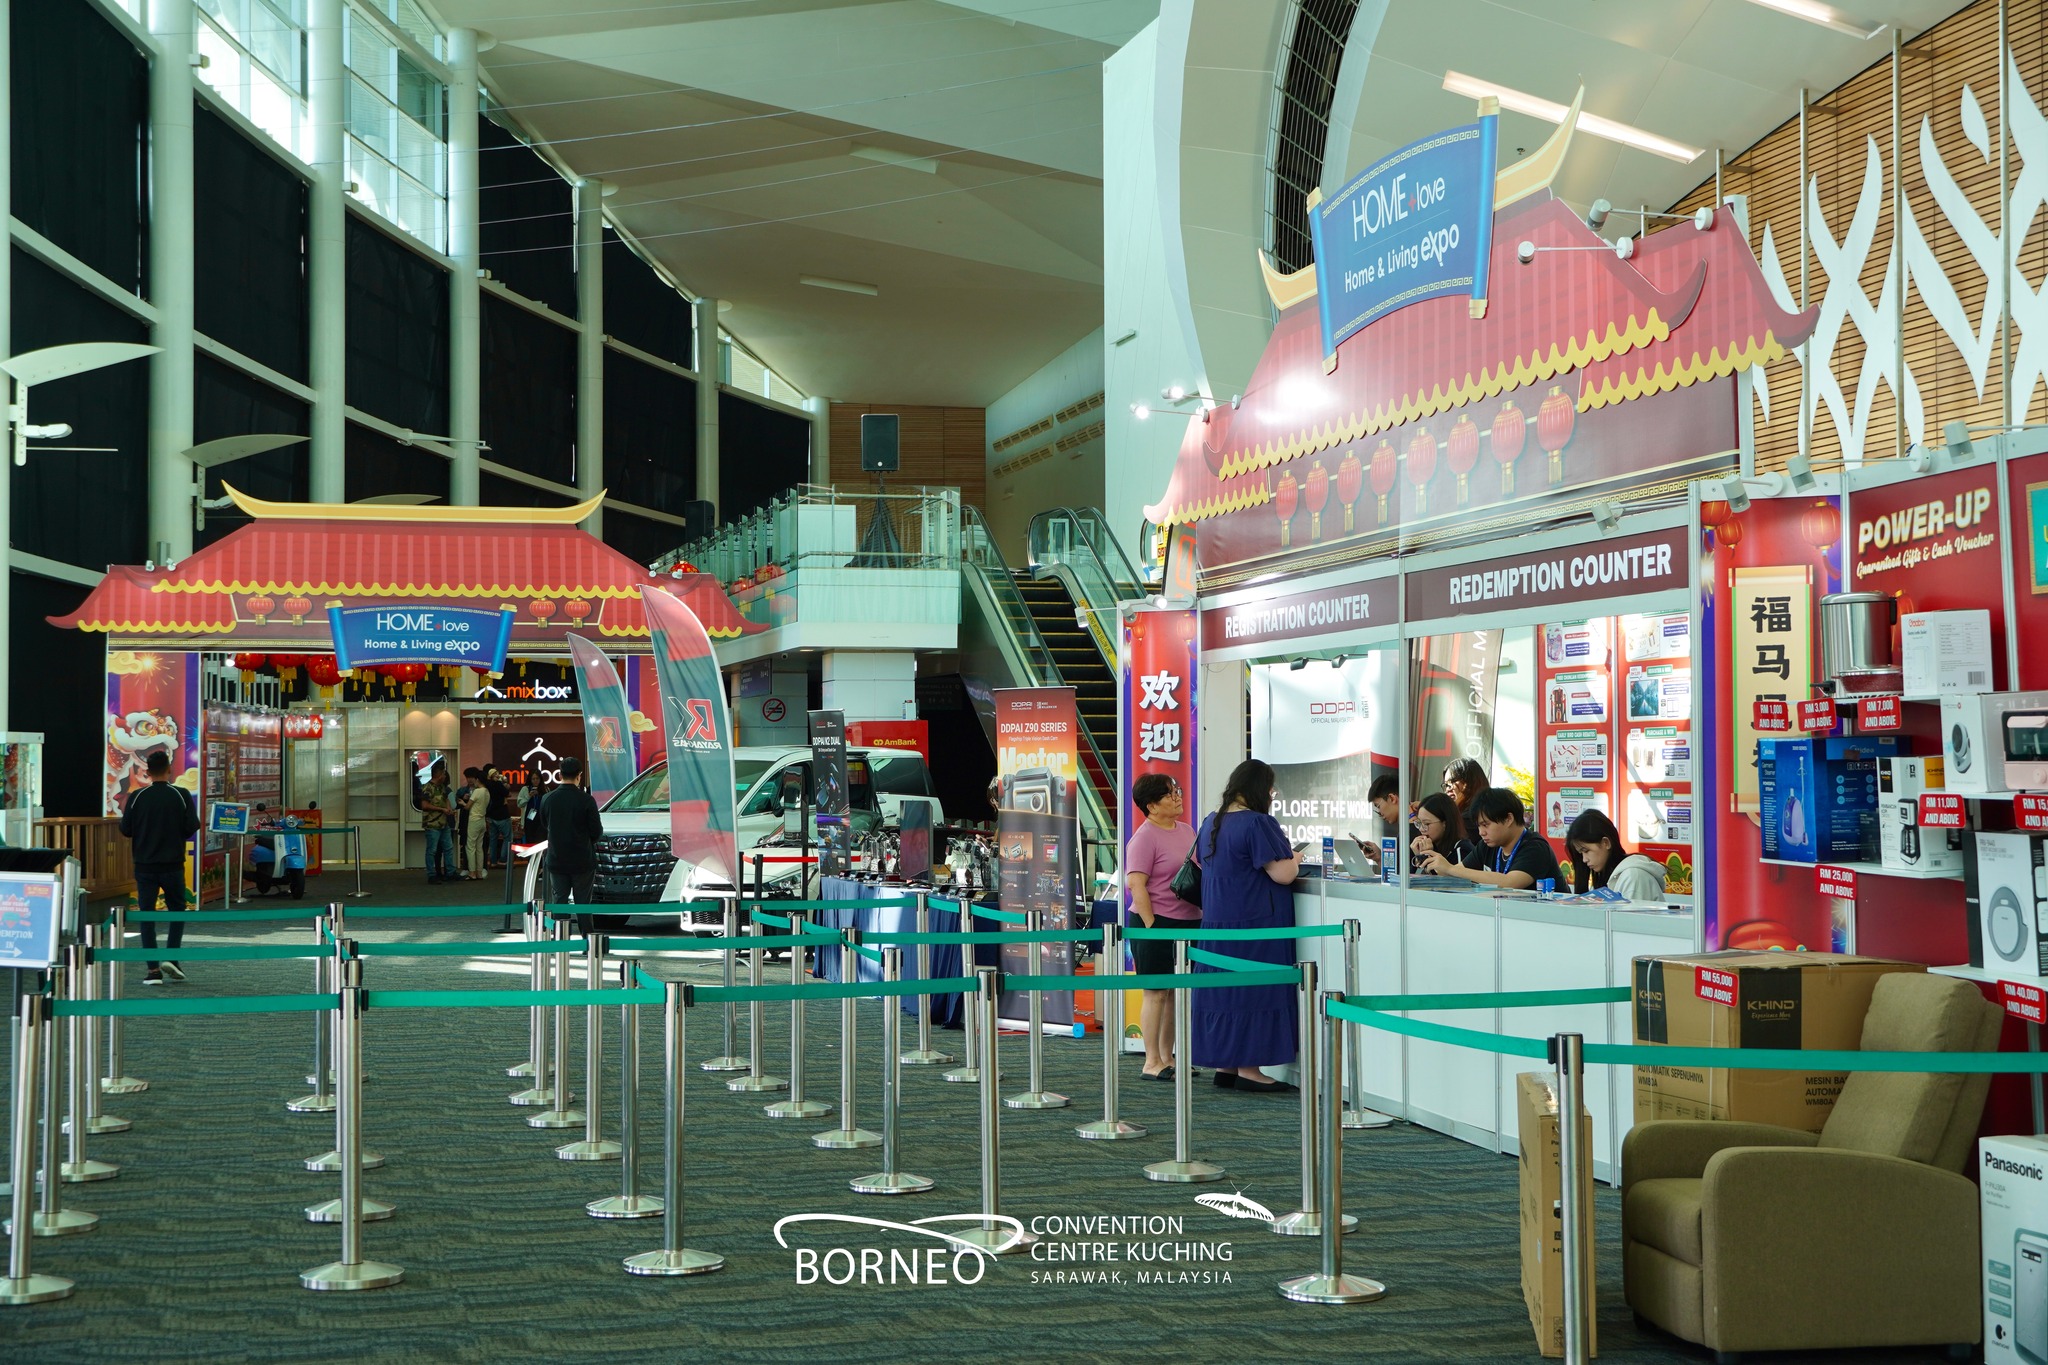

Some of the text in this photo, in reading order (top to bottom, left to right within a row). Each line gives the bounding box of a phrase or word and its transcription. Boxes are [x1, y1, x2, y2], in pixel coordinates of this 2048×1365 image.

[1352, 173, 1445, 241] HOME love
[1345, 223, 1459, 293] Home & Living expo
[1858, 487, 1990, 555] POWER-UP
[1856, 532, 1994, 579] Guaranteed Gifts & Cash Voucher
[1450, 543, 1672, 604] REDEMPTION COUNTER
[377, 613, 469, 632] HOME love
[1226, 593, 1369, 638] REGISTRATION COUNTER
[364, 638, 480, 655] Home & Living expo
[507, 679, 568, 699] mixbox
[1310, 702, 1356, 714] DDPAI
[1467, 657, 1485, 758] OFFICIAL
[1760, 704, 1782, 715] RM 1,000
[1805, 702, 1829, 713] RM 3,000
[1866, 700, 1893, 712] RM 7,000
[1000, 722, 1067, 733] DDPAI Z90 SERIES
[1759, 719, 1785, 728] AND ABOVE
[1804, 716, 1832, 728] AND ABOVE
[1865, 715, 1896, 727] AND ABOVE
[1000, 747, 1068, 775] Master
[1321, 800, 1346, 818] THE
[1926, 797, 1958, 809] RM 11,000
[2023, 798, 2035, 810] RM
[1924, 813, 1959, 824] AND ABOVE
[2025, 815, 2041, 827] AND
[1820, 868, 1852, 883] RM 25,000
[1820, 883, 1854, 898] AND ABOVE
[0, 930, 34, 939] EMPTION
[1702, 970, 1732, 987] RM 55,000
[1639, 989, 1662, 1001] KHIND
[1701, 985, 1732, 1003] AND ABOVE
[2005, 983, 2039, 1002] RM 40,000
[1747, 1000, 1795, 1010] KHIND
[2006, 1000, 2040, 1019] AND ABOVE
[1751, 1012, 1778, 1020] Experience
[1671, 1068, 1704, 1084] SEPENUHNYA
[1806, 1077, 1831, 1085] MESIN
[1806, 1098, 1834, 1106] WM80A
[1985, 1151, 2043, 1180] Panasonic
